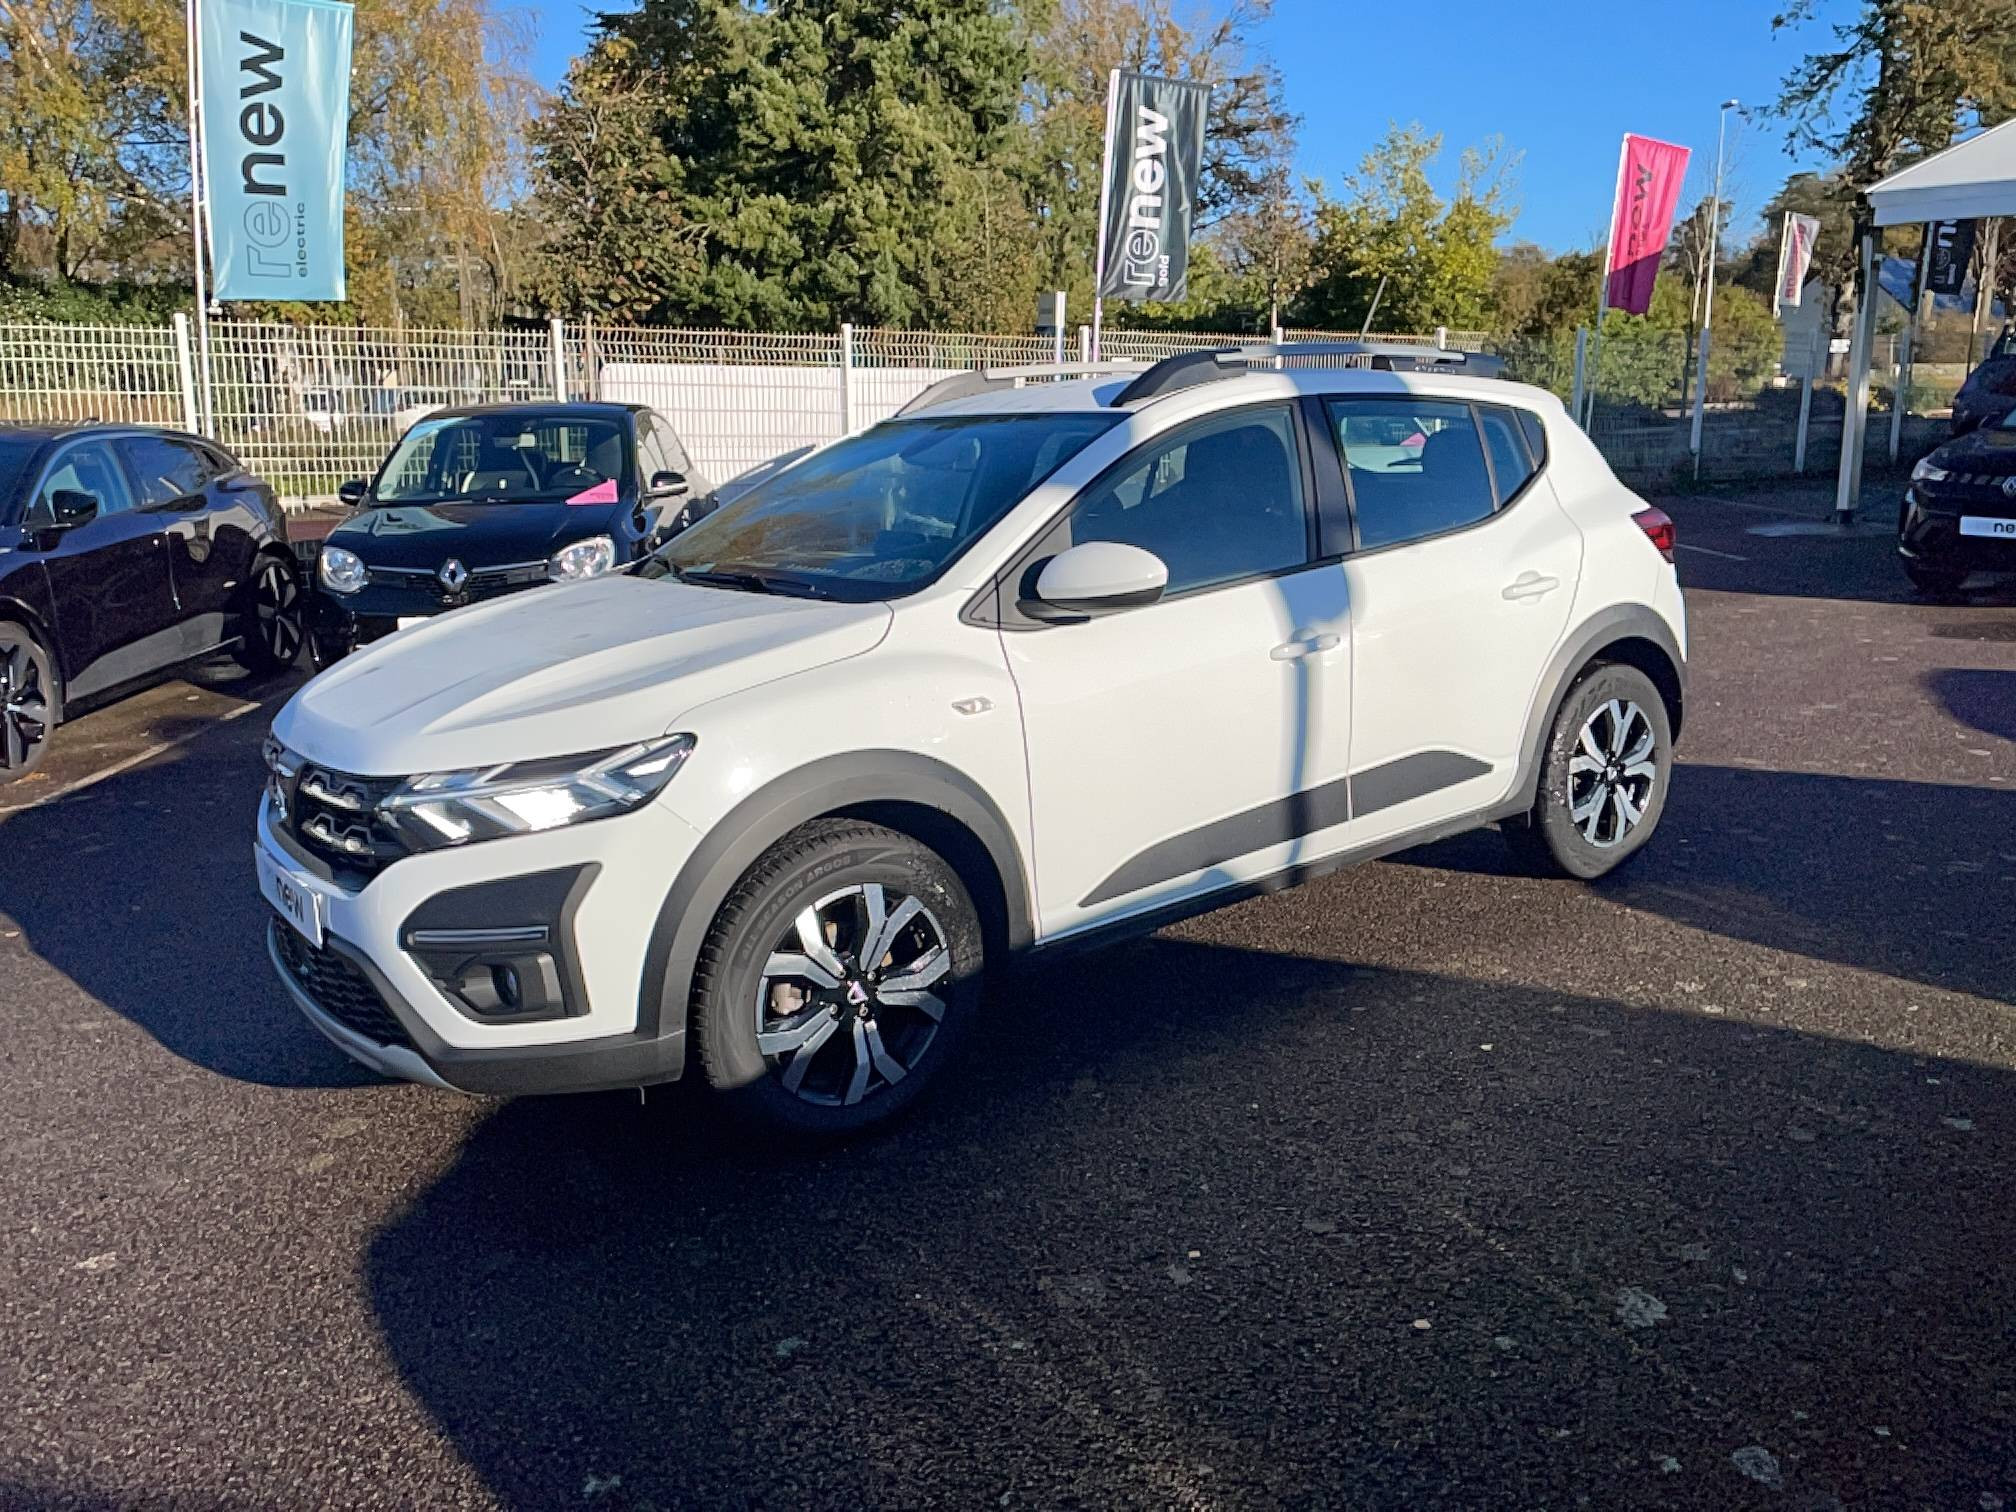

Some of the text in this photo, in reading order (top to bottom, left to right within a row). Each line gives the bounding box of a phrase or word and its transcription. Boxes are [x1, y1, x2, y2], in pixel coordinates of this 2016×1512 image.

[240, 30, 291, 278] renew
[295, 202, 308, 278] electric
[1124, 105, 1168, 286] renew
